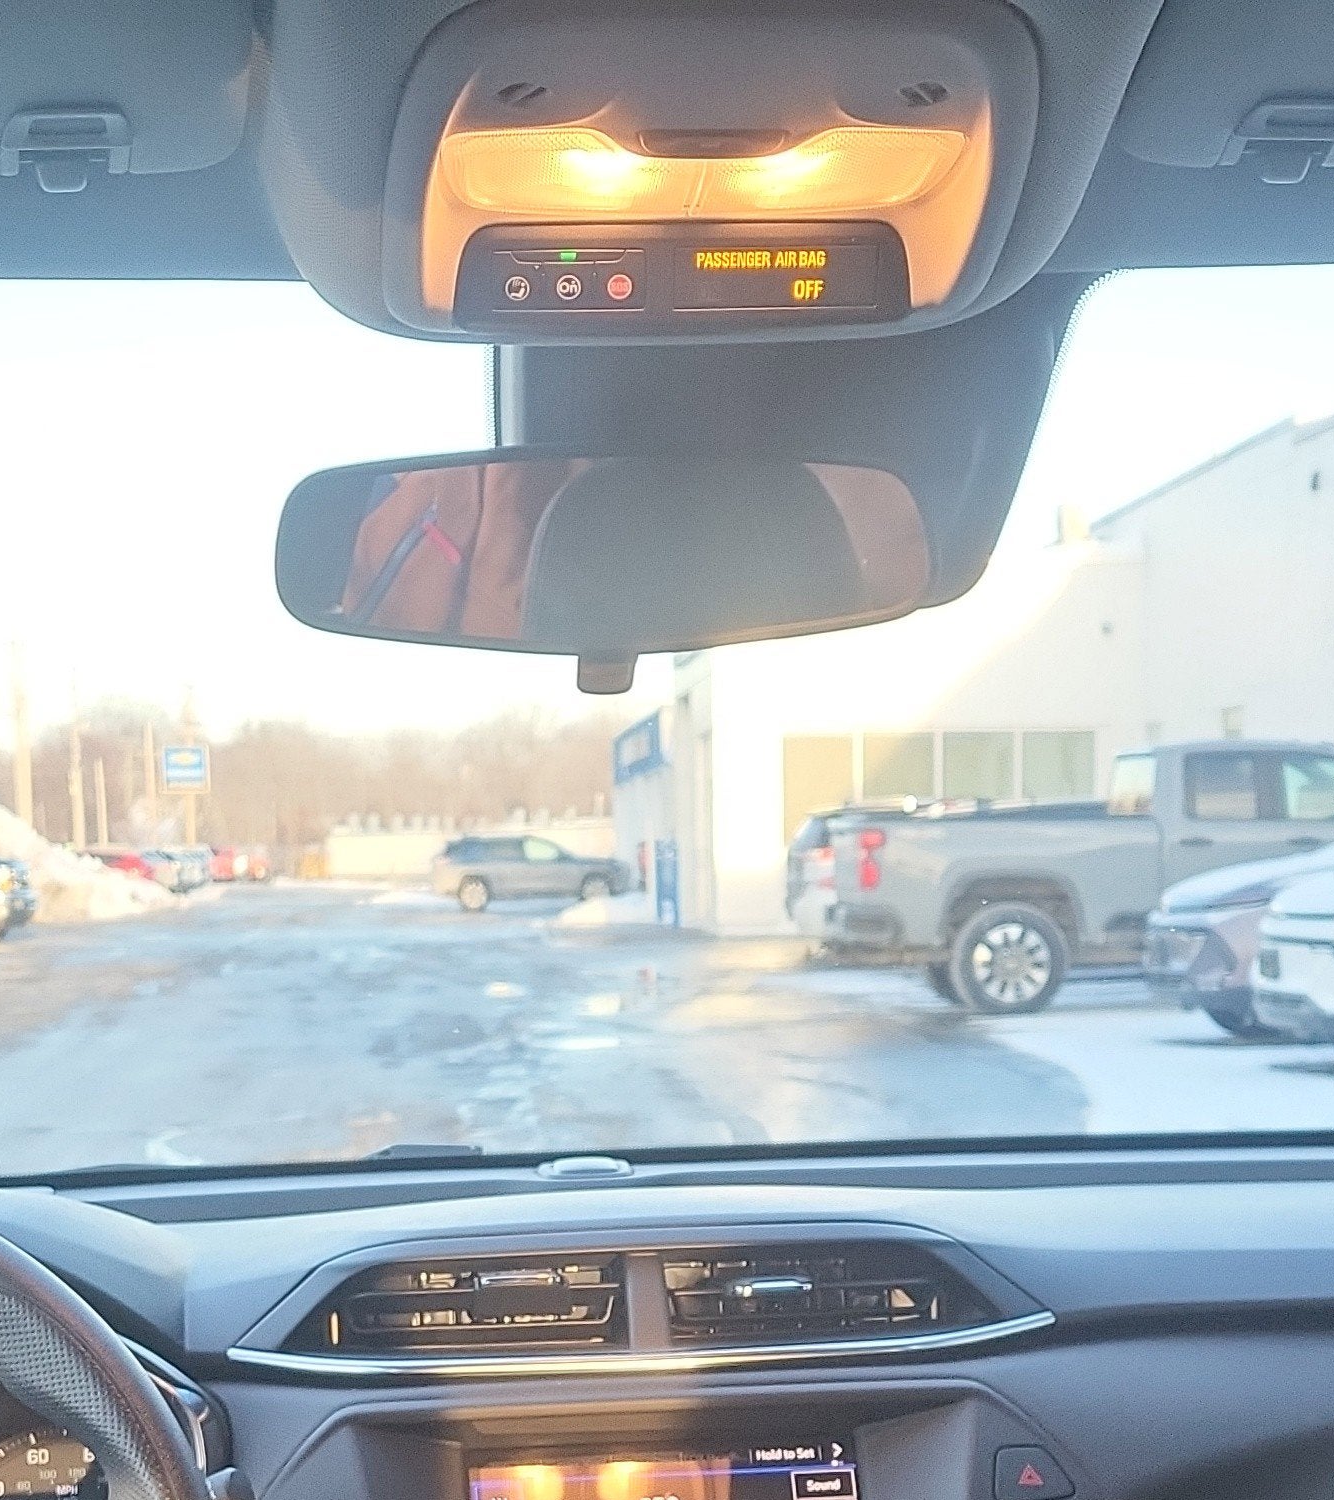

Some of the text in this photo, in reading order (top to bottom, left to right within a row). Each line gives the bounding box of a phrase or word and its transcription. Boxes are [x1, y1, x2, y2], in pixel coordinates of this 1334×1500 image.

[696, 251, 771, 268] PASSENGER
[793, 279, 824, 300] OFF
[27, 1448, 50, 1466] 60
[755, 1447, 816, 1461] Hold to Set
[56, 1485, 78, 1496] MPH
[806, 1478, 841, 1493] Sound
